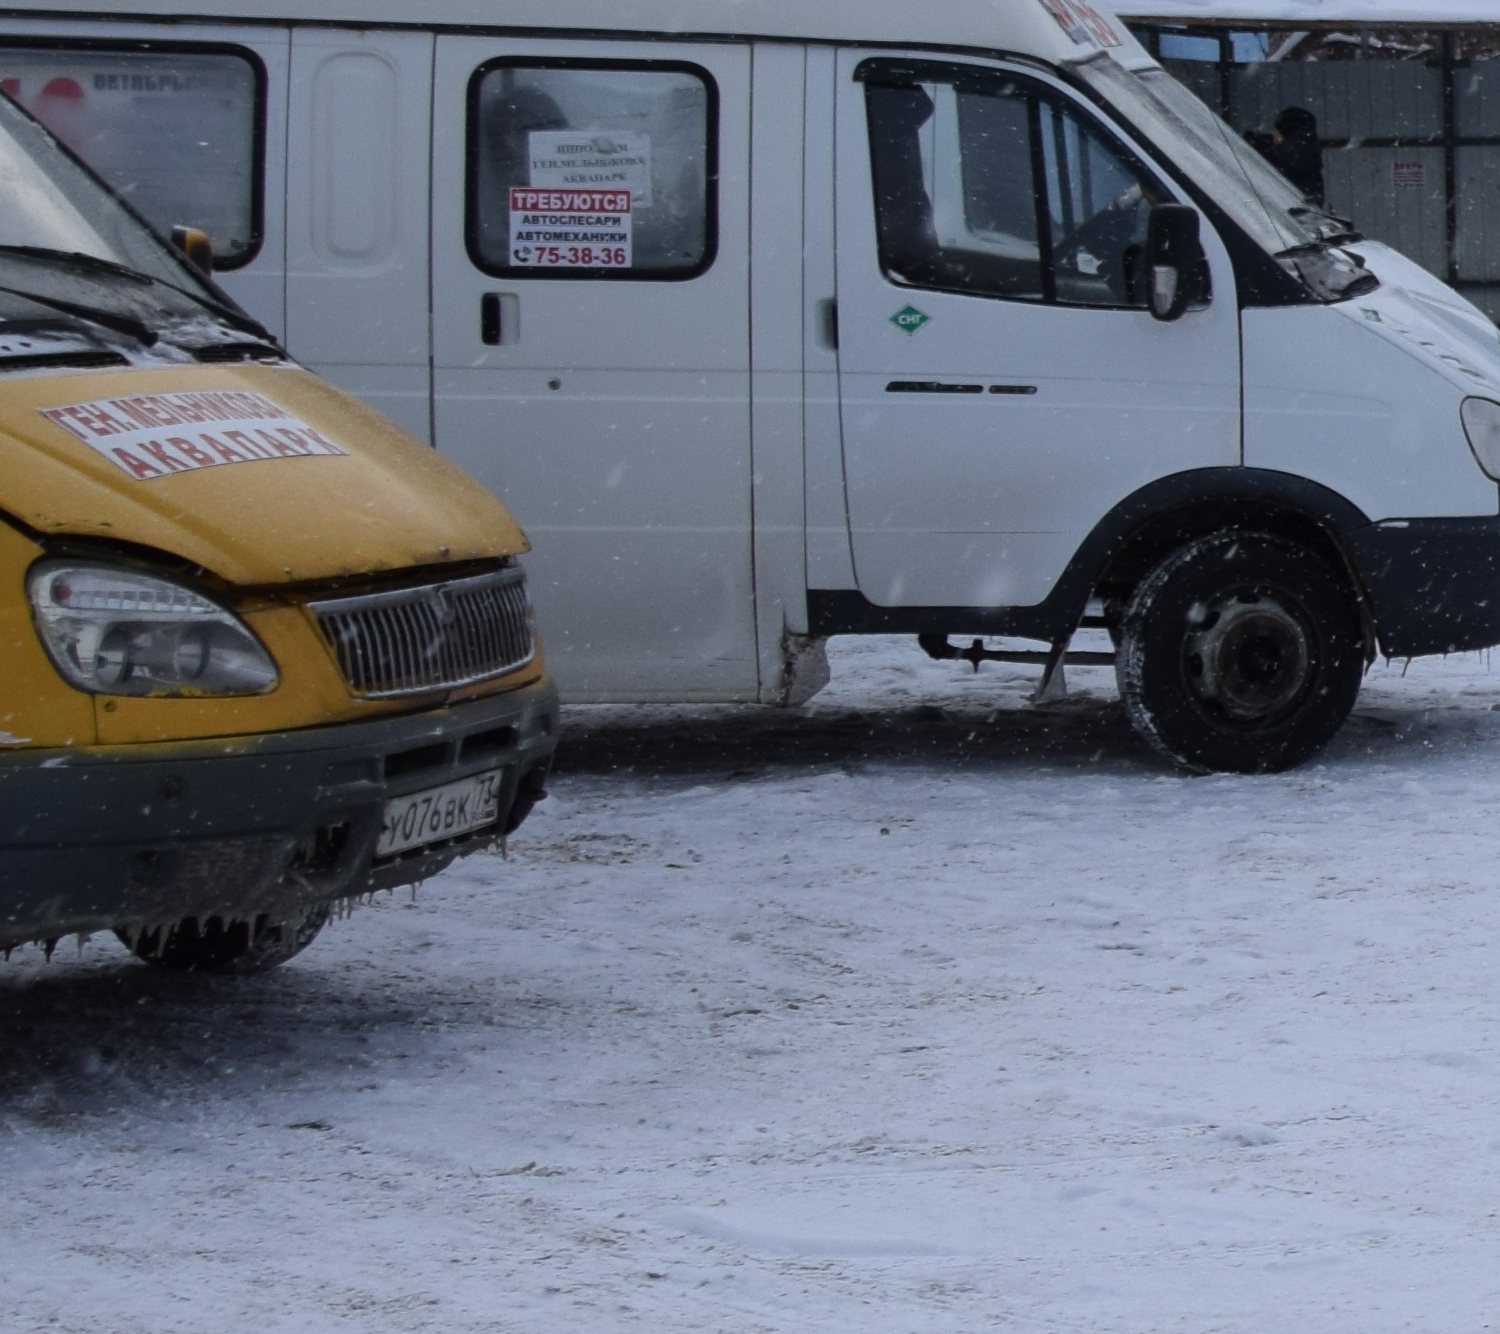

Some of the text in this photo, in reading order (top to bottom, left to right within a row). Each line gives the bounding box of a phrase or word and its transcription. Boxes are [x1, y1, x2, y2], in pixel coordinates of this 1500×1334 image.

[562, 172, 627, 184] АКВАПАРК
[513, 193, 628, 211] ТРЕБУЮТСЯ
[521, 215, 622, 226] АВТОСЛЕСАРИ
[515, 231, 628, 243] АВТОМЕХАНИКИ
[533, 246, 627, 265] 75-38-36
[110, 427, 346, 479] АКВАПАРК
